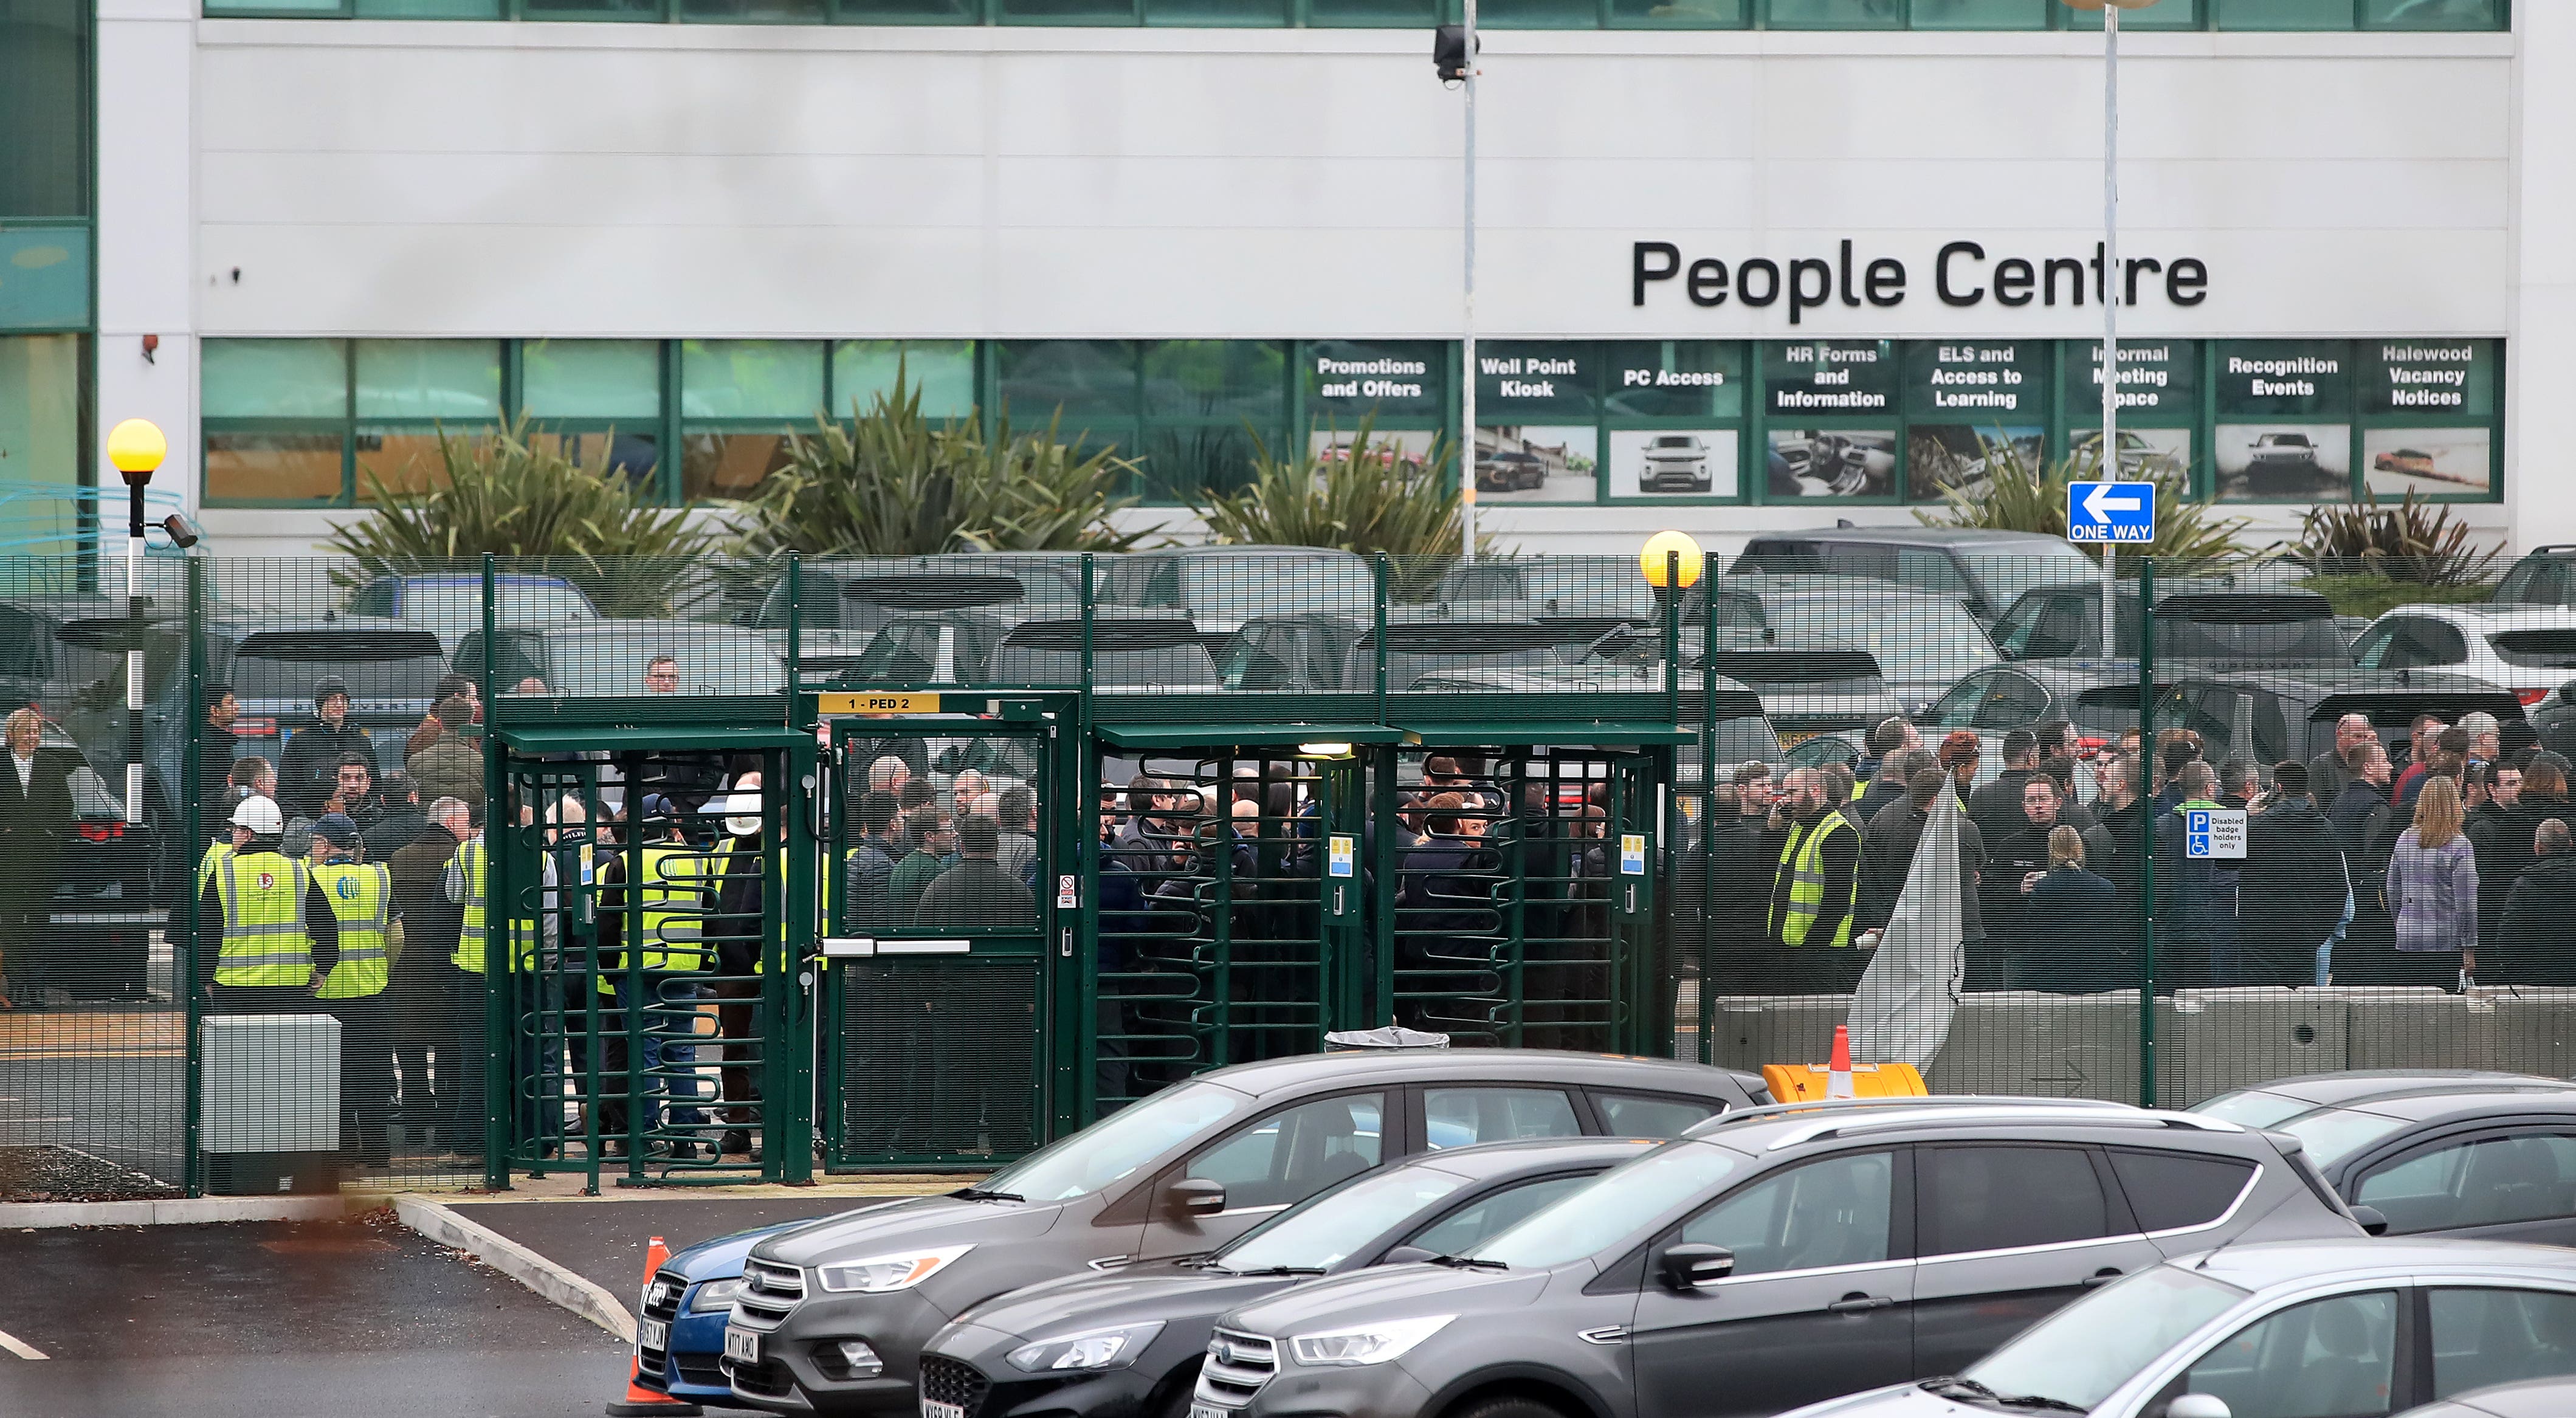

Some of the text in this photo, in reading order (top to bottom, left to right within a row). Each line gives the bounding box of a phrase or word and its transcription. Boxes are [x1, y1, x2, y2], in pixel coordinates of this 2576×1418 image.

[1633, 239, 2208, 325] People Centre
[1786, 346, 1877, 363] HR Forms
[1938, 346, 2014, 363] ELS and
[2092, 346, 2169, 362] Inormal
[2383, 345, 2472, 362] Halewood
[1318, 357, 1426, 375] Promotions
[1480, 358, 1576, 375] Well Point
[2229, 357, 2338, 377] Recognition
[1624, 369, 1723, 386] PC Access
[1814, 368, 1849, 385] and
[1931, 368, 2022, 385] Access to
[2389, 367, 2465, 387] Vacancy
[1321, 380, 1422, 397] and Offers
[1500, 380, 1554, 397] Kiosk
[2252, 379, 2315, 396] Events
[1777, 390, 1885, 407] Information
[1935, 390, 2017, 410] Learning
[2101, 392, 2159, 409] pace
[2392, 389, 2462, 405] Notices
[2071, 525, 2151, 539] ONE WAY
[849, 699, 855, 709] 1
[869, 698, 897, 709] PED
[901, 698, 909, 709] 2
[2194, 814, 2206, 831] P
